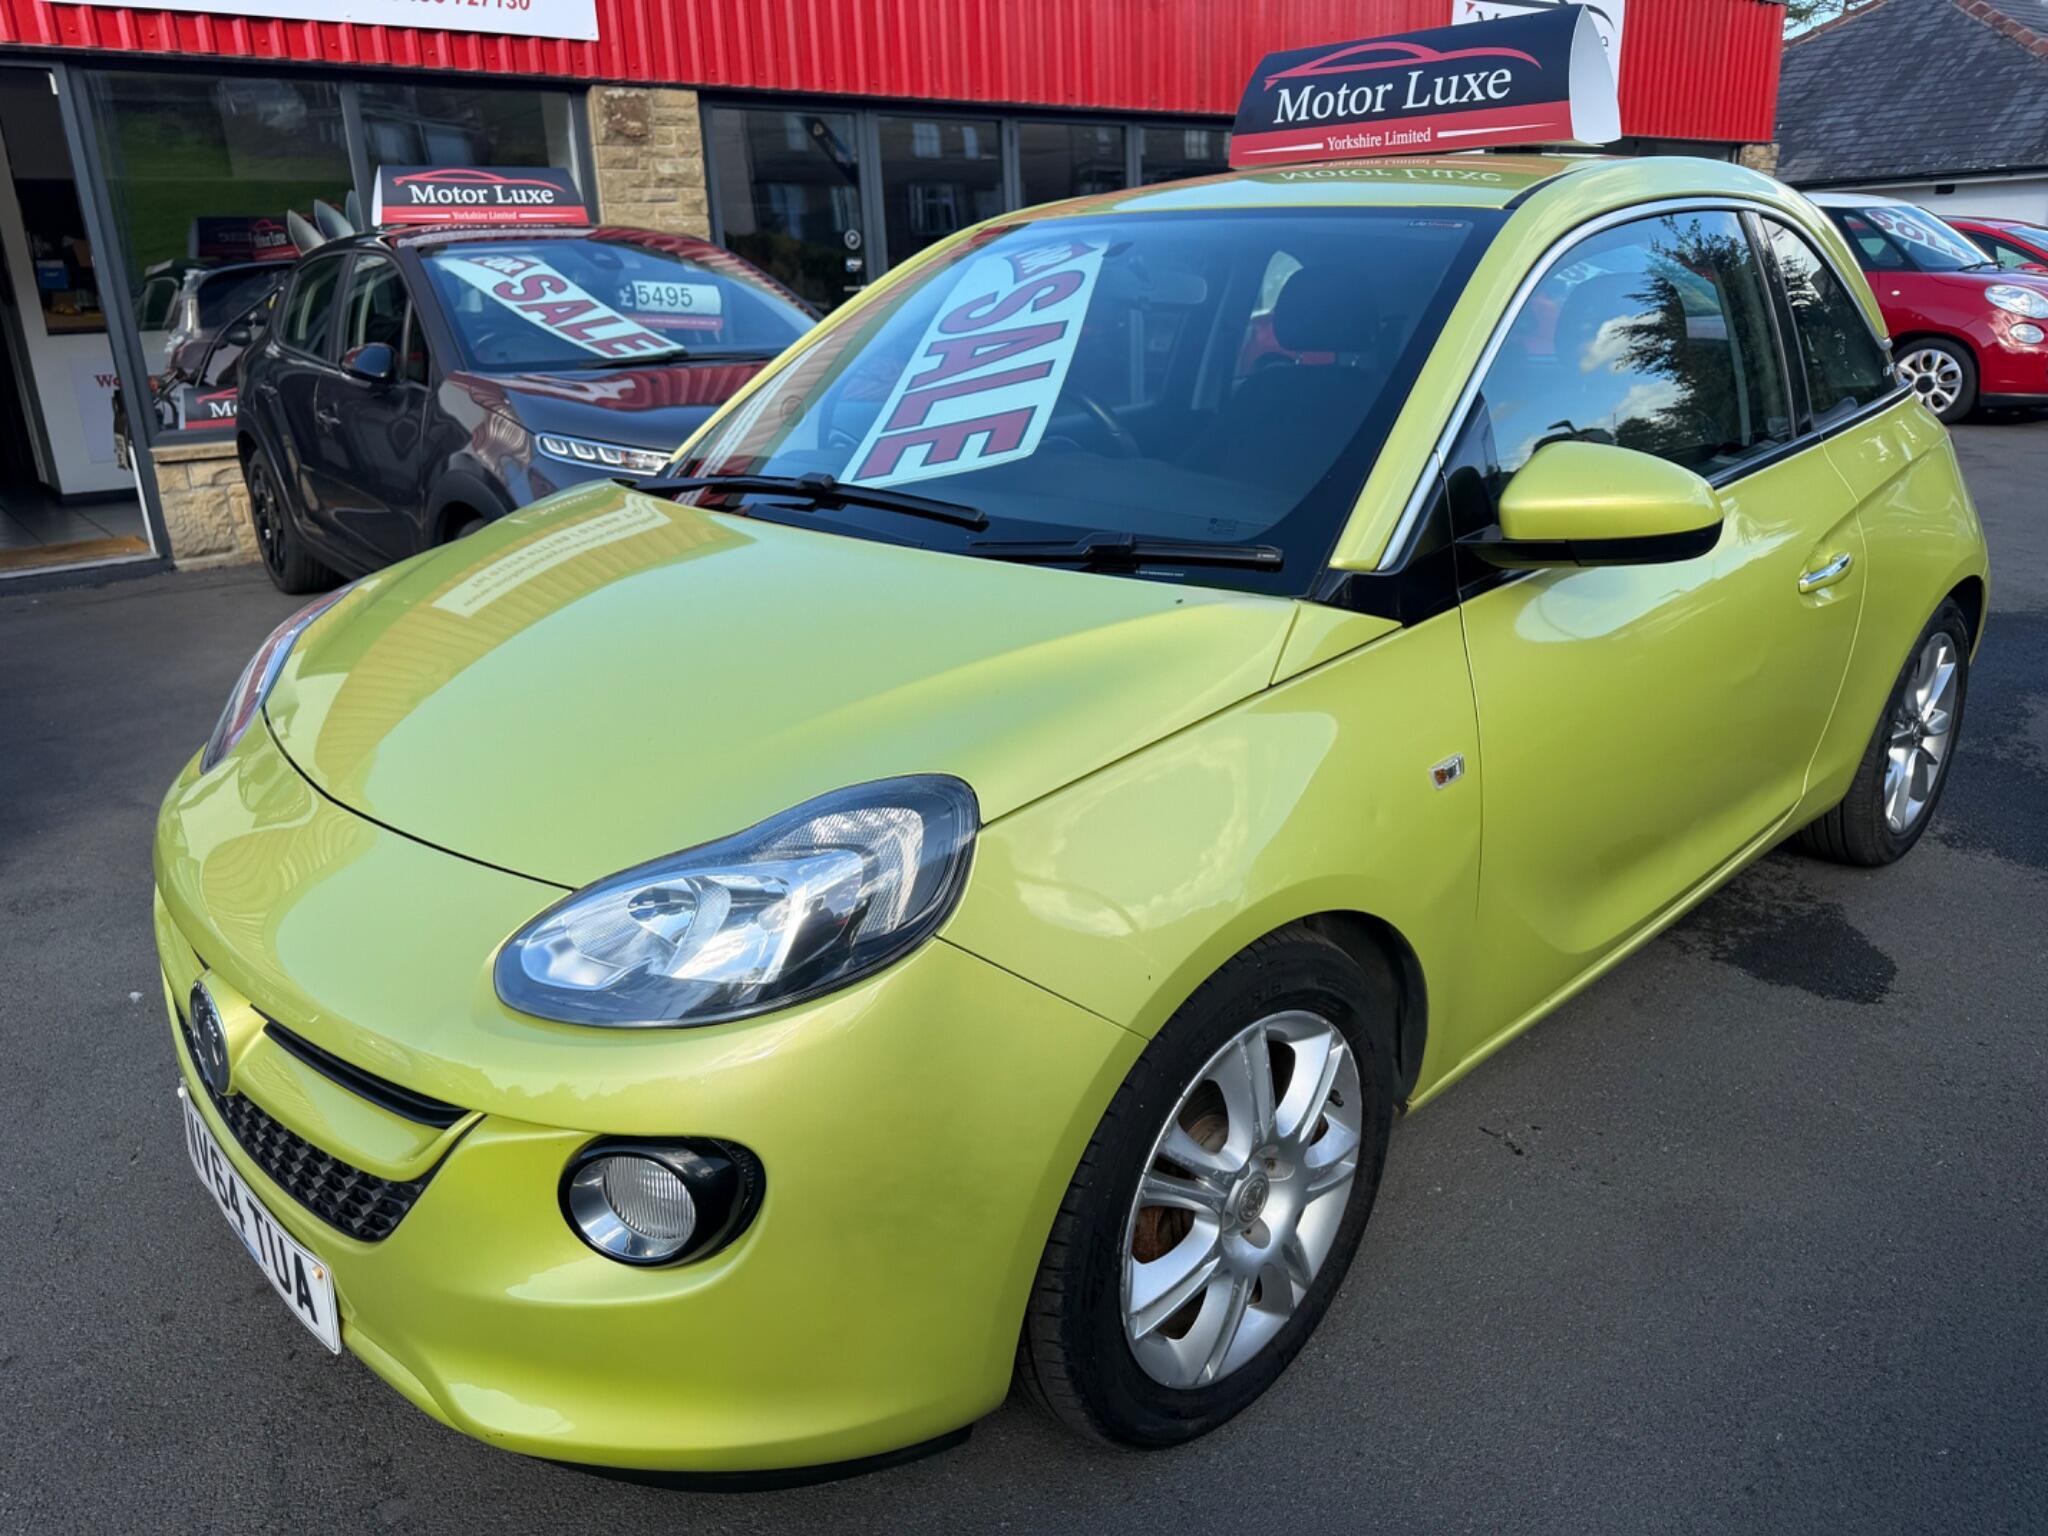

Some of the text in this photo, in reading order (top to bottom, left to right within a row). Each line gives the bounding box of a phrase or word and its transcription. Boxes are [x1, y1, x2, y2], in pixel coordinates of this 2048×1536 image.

[1273, 67, 1513, 124] Motor Luxe
[1327, 127, 1432, 152] Yorkshire Limited
[408, 184, 555, 204] Motor Luxe
[451, 211, 518, 220] Yorkshire Limited
[492, 273, 673, 357] SALE
[851, 268, 1086, 482] SALE
[246, 1196, 319, 1326] TUA
